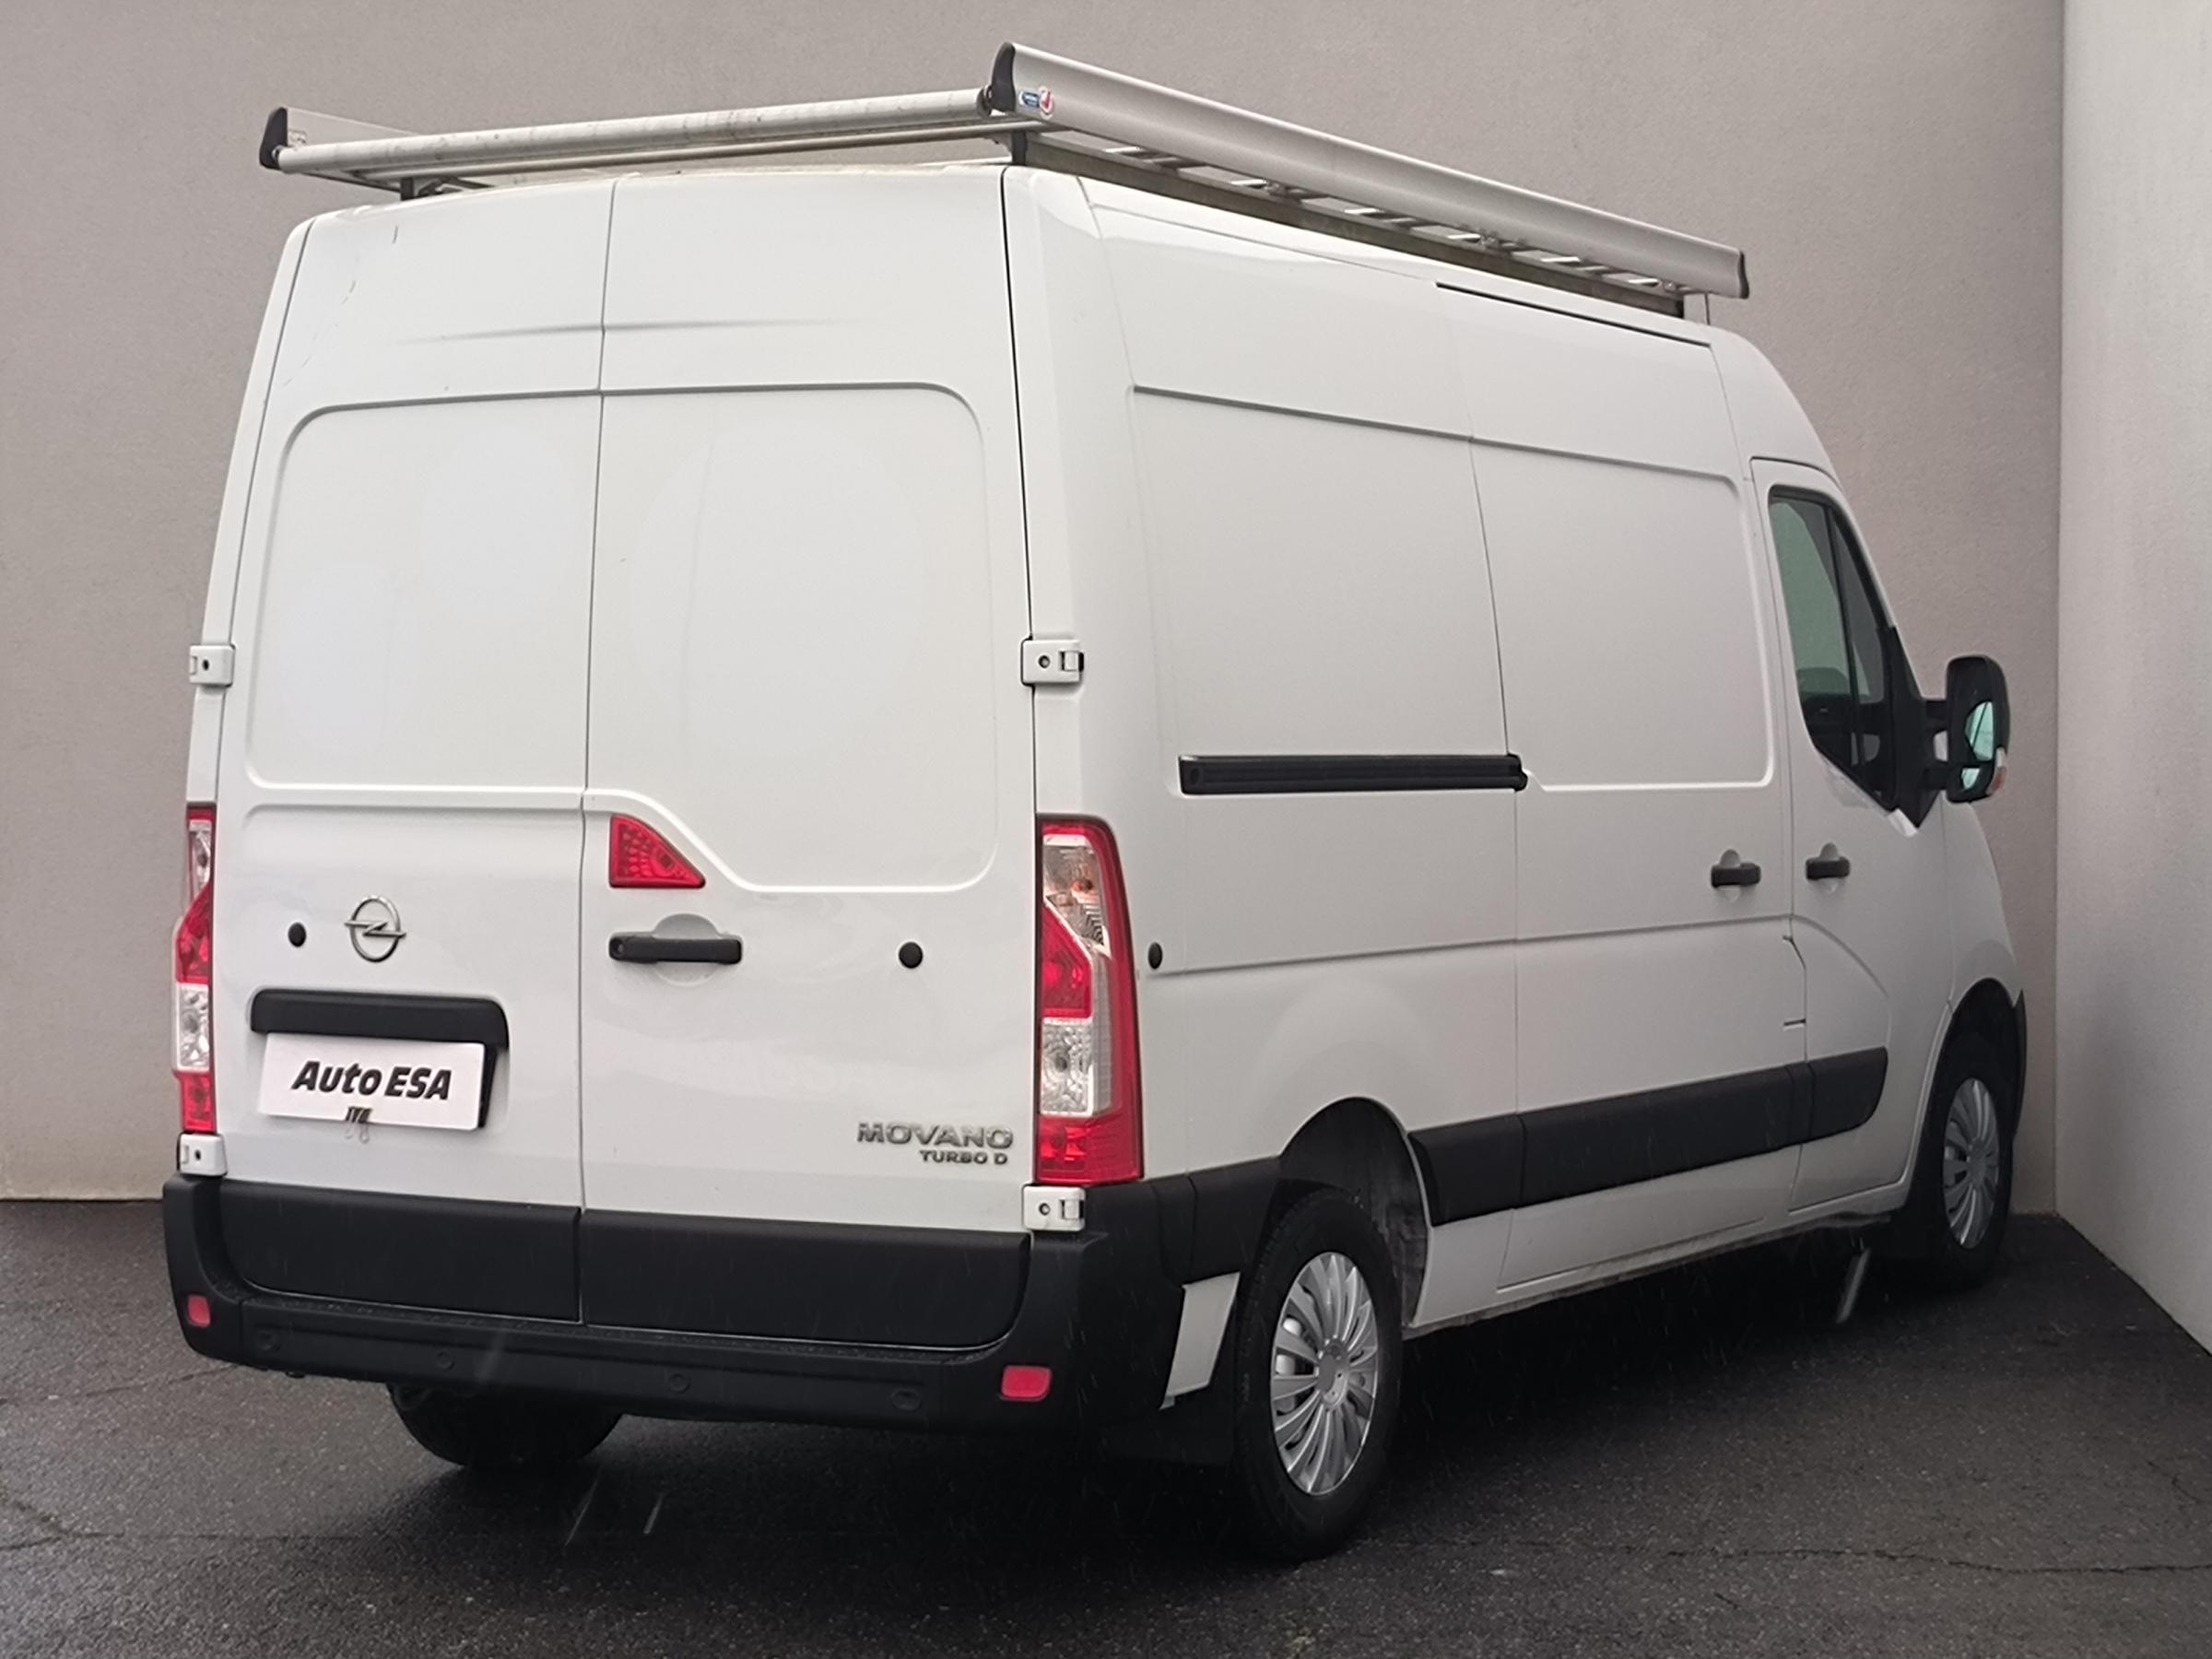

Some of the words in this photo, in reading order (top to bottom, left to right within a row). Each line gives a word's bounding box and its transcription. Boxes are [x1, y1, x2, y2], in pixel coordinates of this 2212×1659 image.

[291, 1061, 382, 1095] Auto
[384, 1066, 452, 1100] ESA
[857, 1123, 1013, 1149] MOVANO
[920, 1150, 988, 1164] TURBO
[994, 1153, 1007, 1165] D
